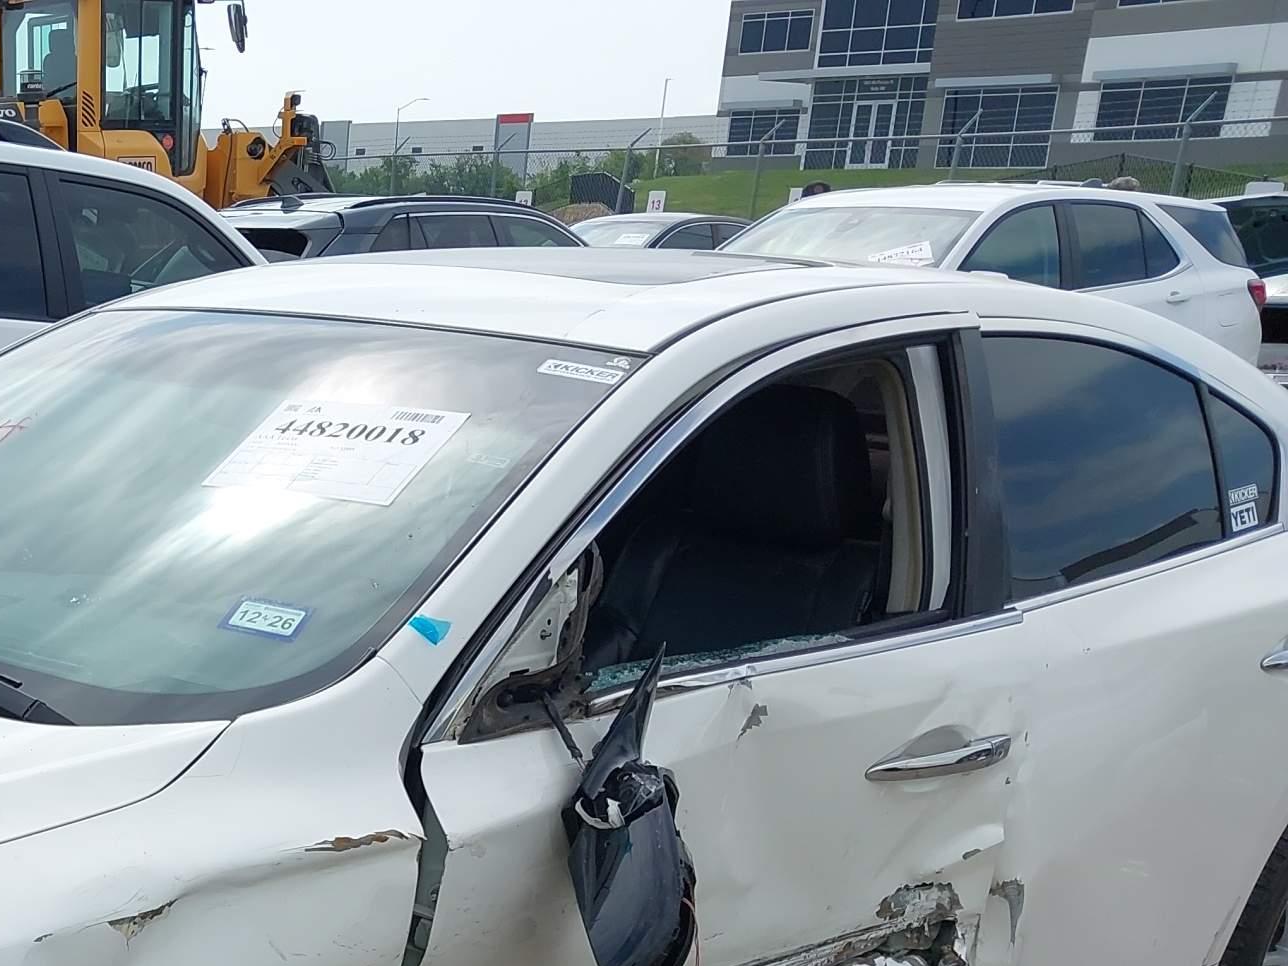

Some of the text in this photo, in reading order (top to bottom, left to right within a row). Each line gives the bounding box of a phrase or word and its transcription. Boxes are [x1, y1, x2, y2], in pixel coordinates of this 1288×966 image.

[651, 199, 662, 211] 13
[561, 363, 621, 379] KICKER
[274, 418, 427, 447] 44820018
[1232, 506, 1257, 527] YETI
